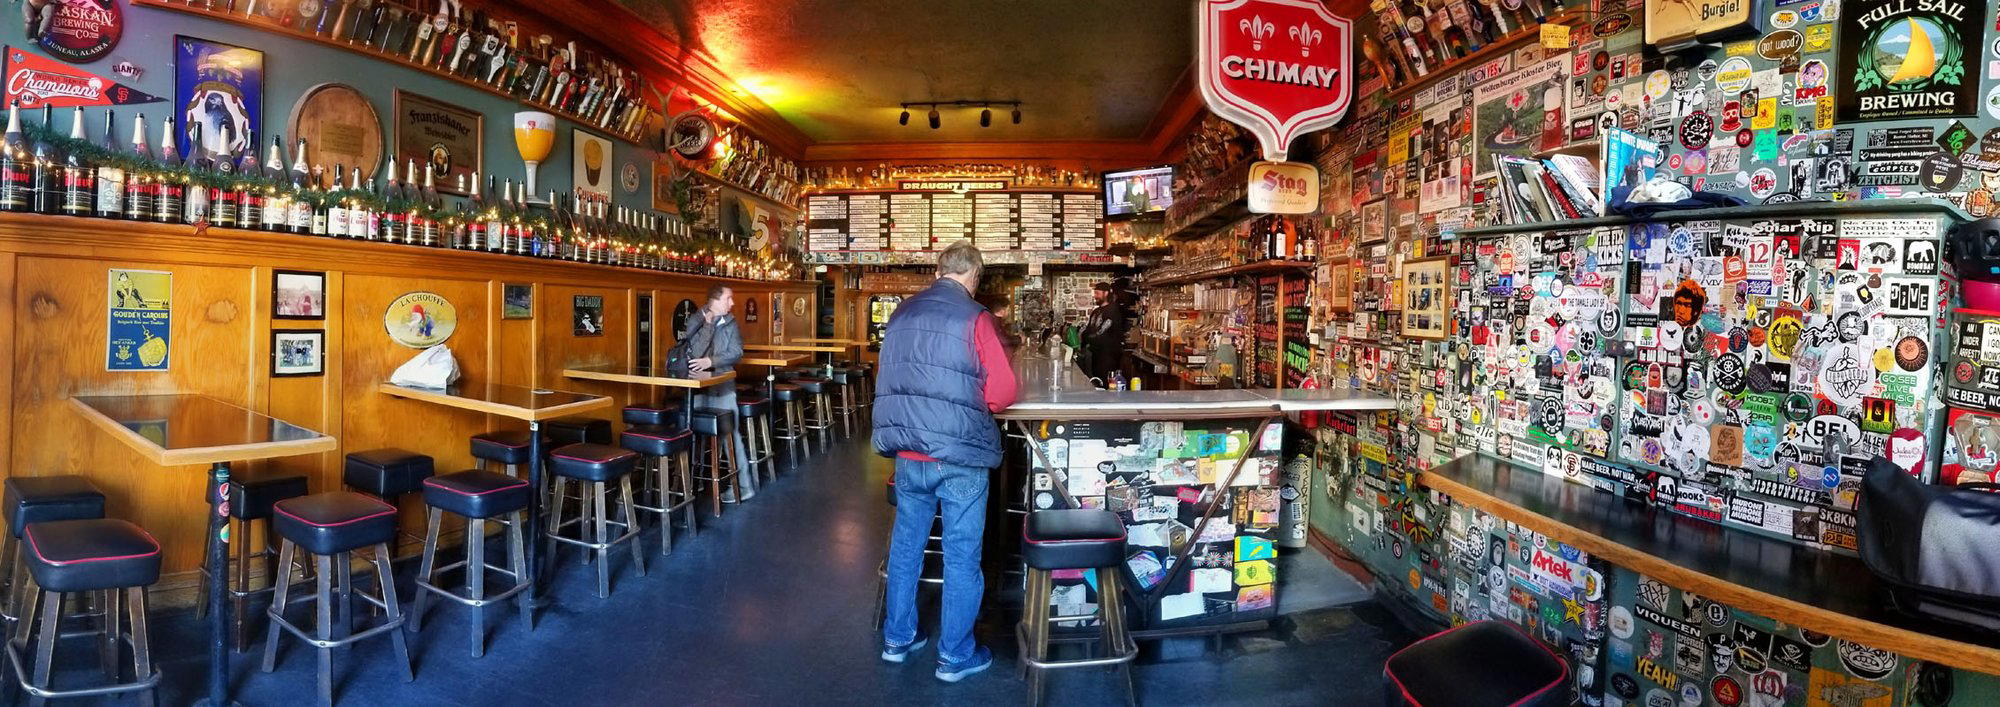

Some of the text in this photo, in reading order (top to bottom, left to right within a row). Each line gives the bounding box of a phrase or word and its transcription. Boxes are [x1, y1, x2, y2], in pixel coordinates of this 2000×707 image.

[58, 5, 114, 28] ASKAN
[1702, 1, 1742, 20] Burgie!
[1857, 0, 1966, 29] FULL SAIL
[54, 17, 99, 33] BREWING
[80, 43, 109, 57] ALASKA
[1762, 35, 1799, 54] got wood?
[1220, 55, 1338, 88] CHIMAY
[1488, 63, 1499, 78] YES
[8, 68, 100, 97] Champions
[1860, 92, 1955, 111] BREWING
[1873, 163, 1915, 172] CORPSES
[903, 182, 958, 190] DRAUGHT
[1262, 170, 1307, 198] Stag
[1858, 175, 1918, 186] ZEITGEIST
[1598, 229, 1624, 246] THE FIX
[1754, 221, 1833, 236] Solar Rip
[1598, 245, 1624, 266] KICKS
[1749, 243, 1769, 263] 12
[401, 298, 411, 307] LA
[1882, 375, 1917, 385] GO SEE
[1888, 384, 1909, 393] LIVE
[1961, 391, 1987, 406] BEER,
[1611, 467, 1622, 479] NOT
[1678, 490, 1704, 502] HOOKS
[1751, 479, 1815, 503] SIDERUNNERS
[1532, 550, 1572, 583] Artek
[1636, 606, 1701, 638] VIQUEEN
[1636, 656, 1678, 690] YEAH!
